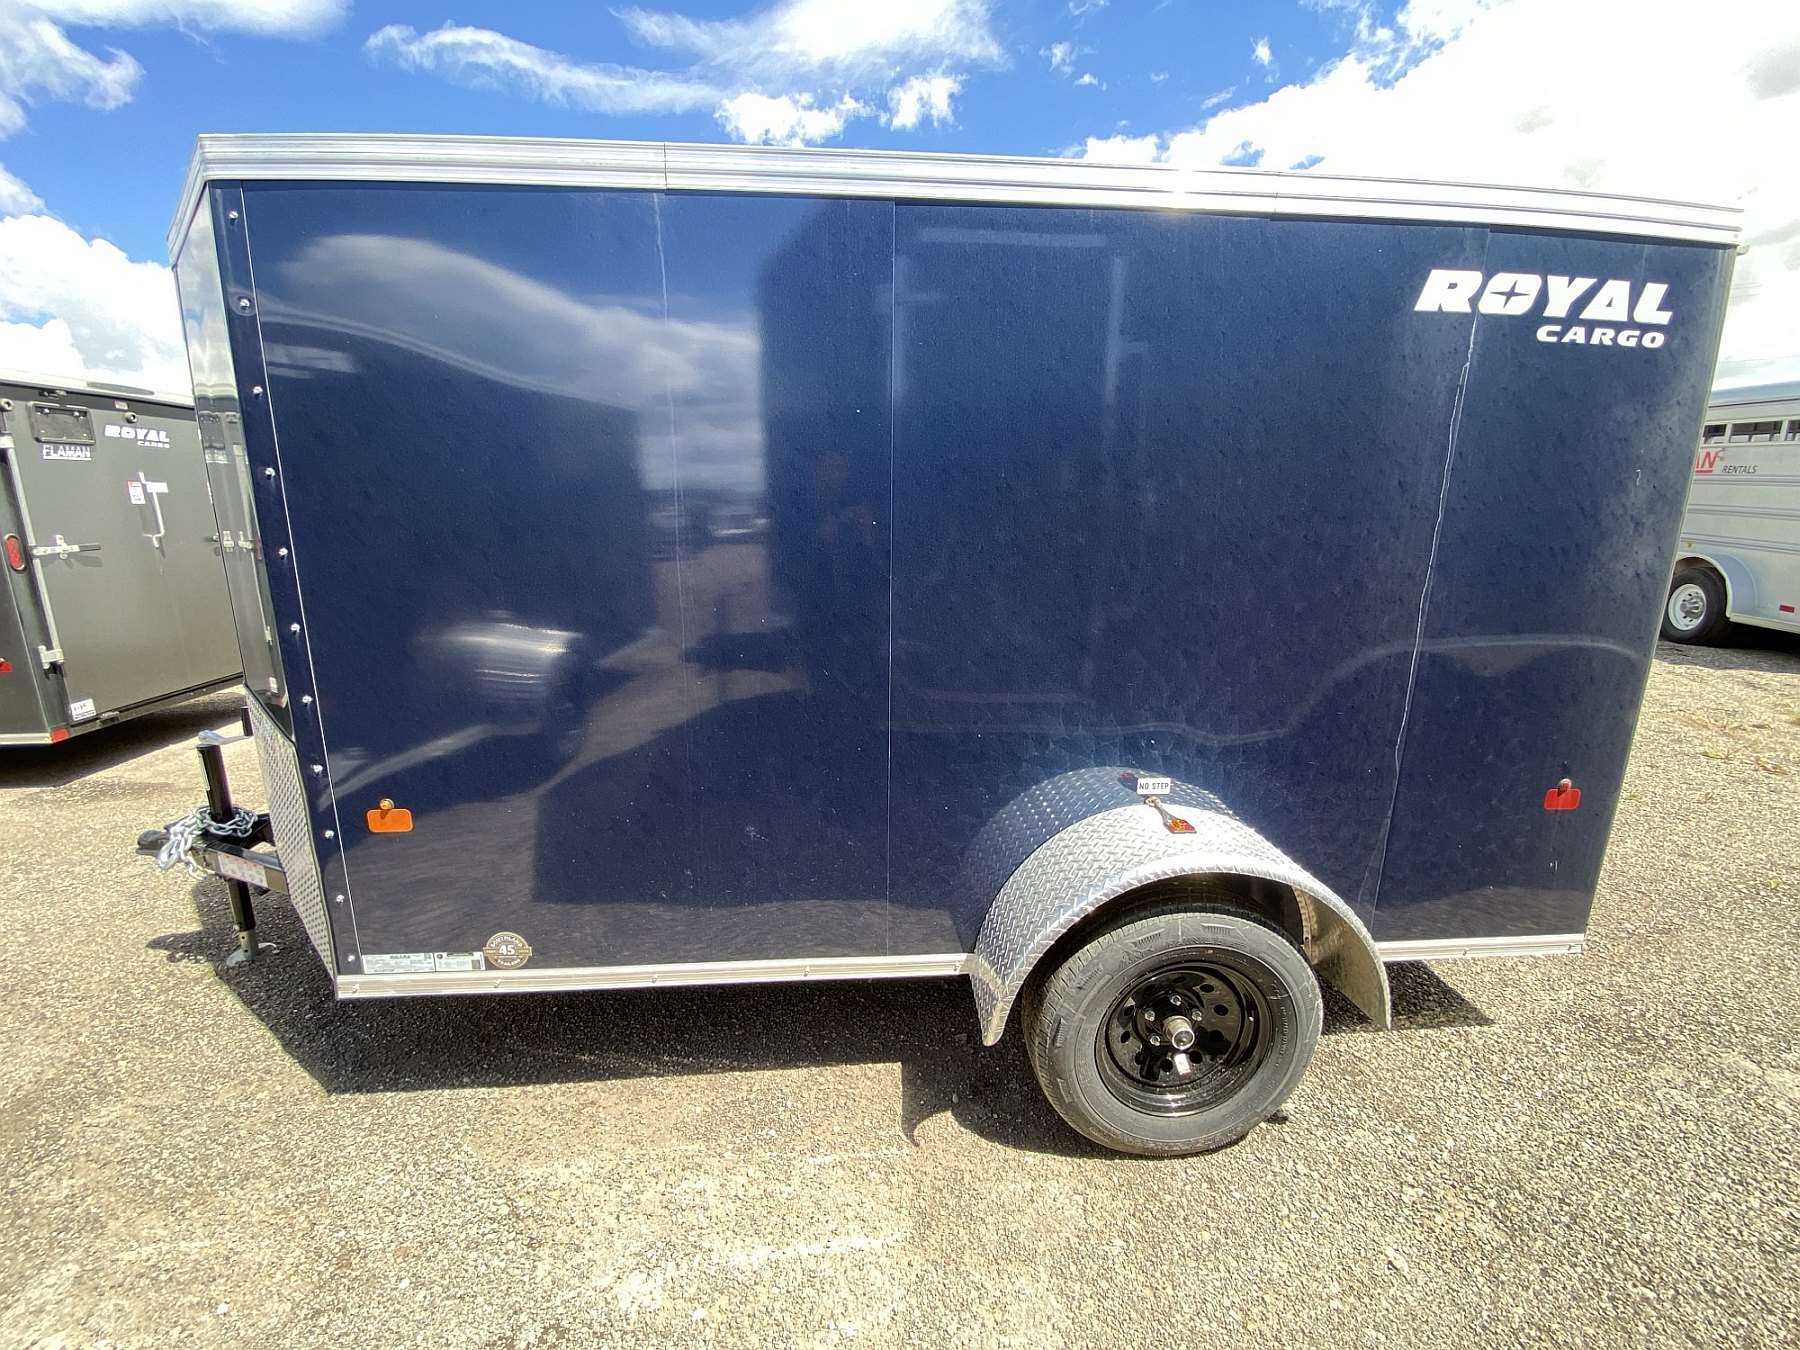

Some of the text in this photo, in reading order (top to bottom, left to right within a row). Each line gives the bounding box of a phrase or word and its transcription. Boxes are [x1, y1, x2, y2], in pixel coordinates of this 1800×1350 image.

[1413, 269, 1673, 325] ROYAL
[1536, 325, 1665, 348] CARGO
[104, 424, 170, 442] ROYAL
[43, 444, 91, 458] FLAMAN
[1722, 465, 1758, 474] RENTALS
[499, 944, 516, 955] 45
